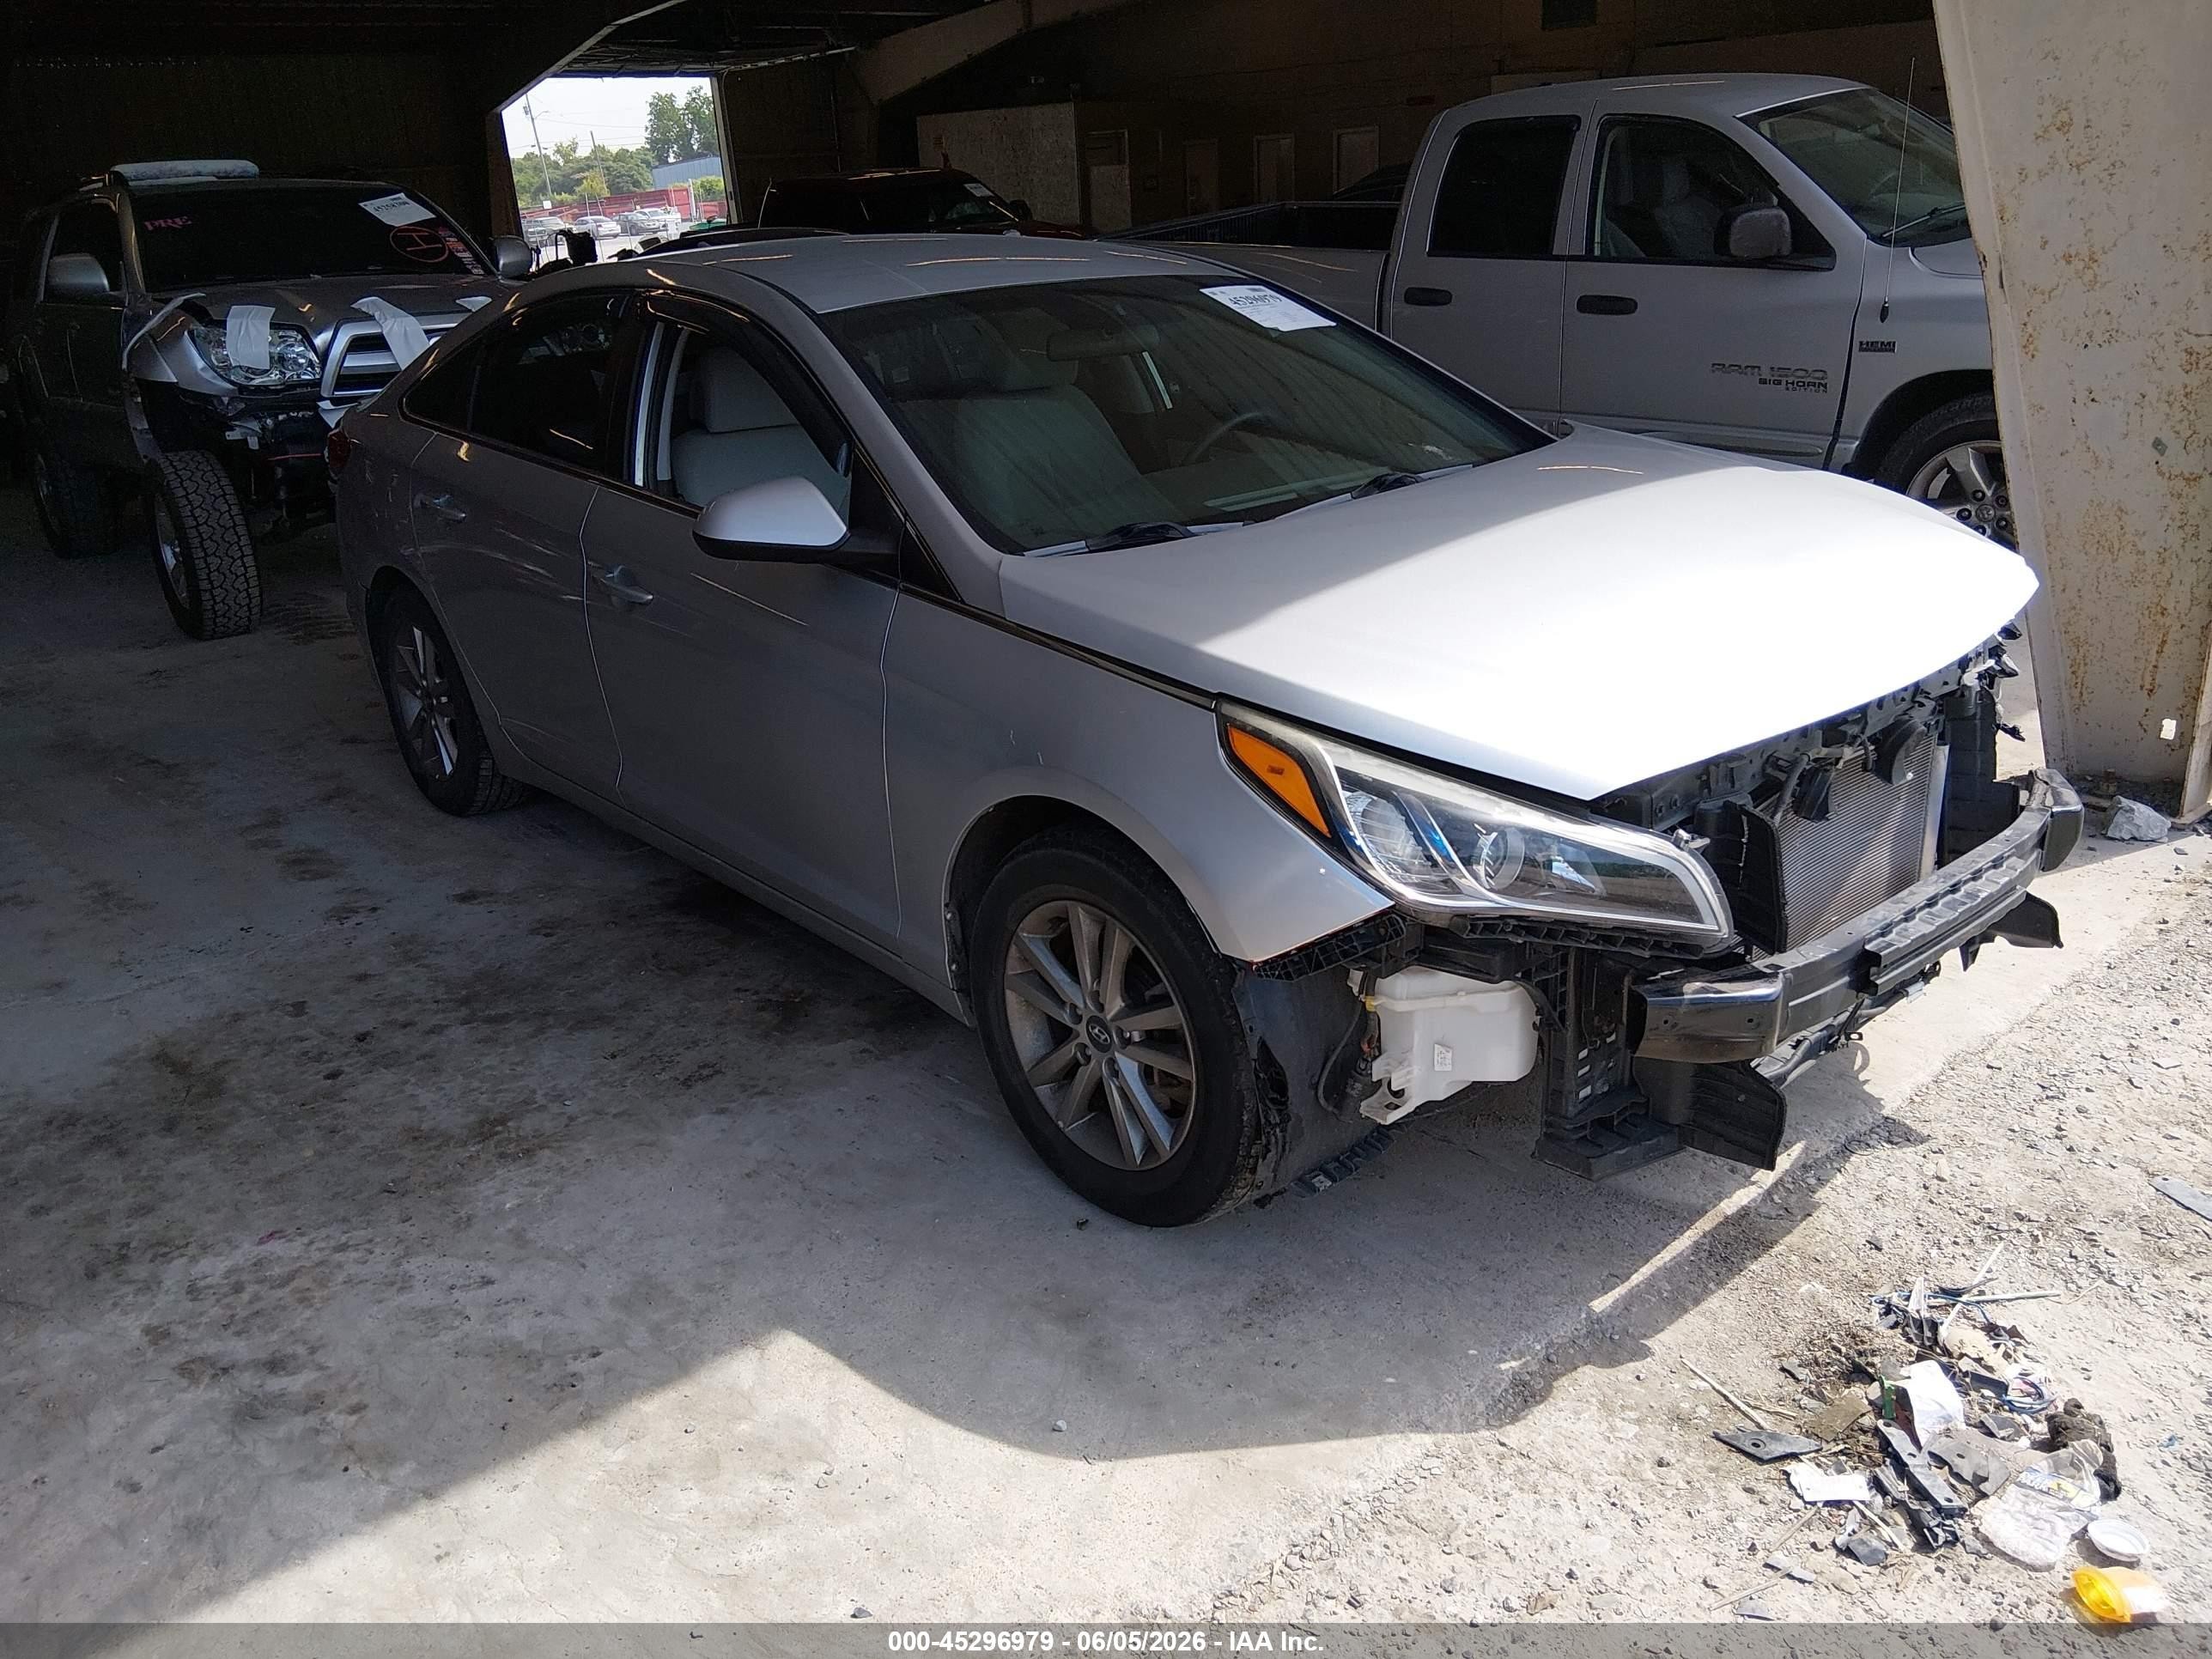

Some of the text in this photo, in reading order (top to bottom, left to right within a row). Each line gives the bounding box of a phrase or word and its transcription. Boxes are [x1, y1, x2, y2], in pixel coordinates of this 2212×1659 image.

[1711, 362, 1828, 380] RAM 1500
[1758, 377, 1828, 389] BIG HORN
